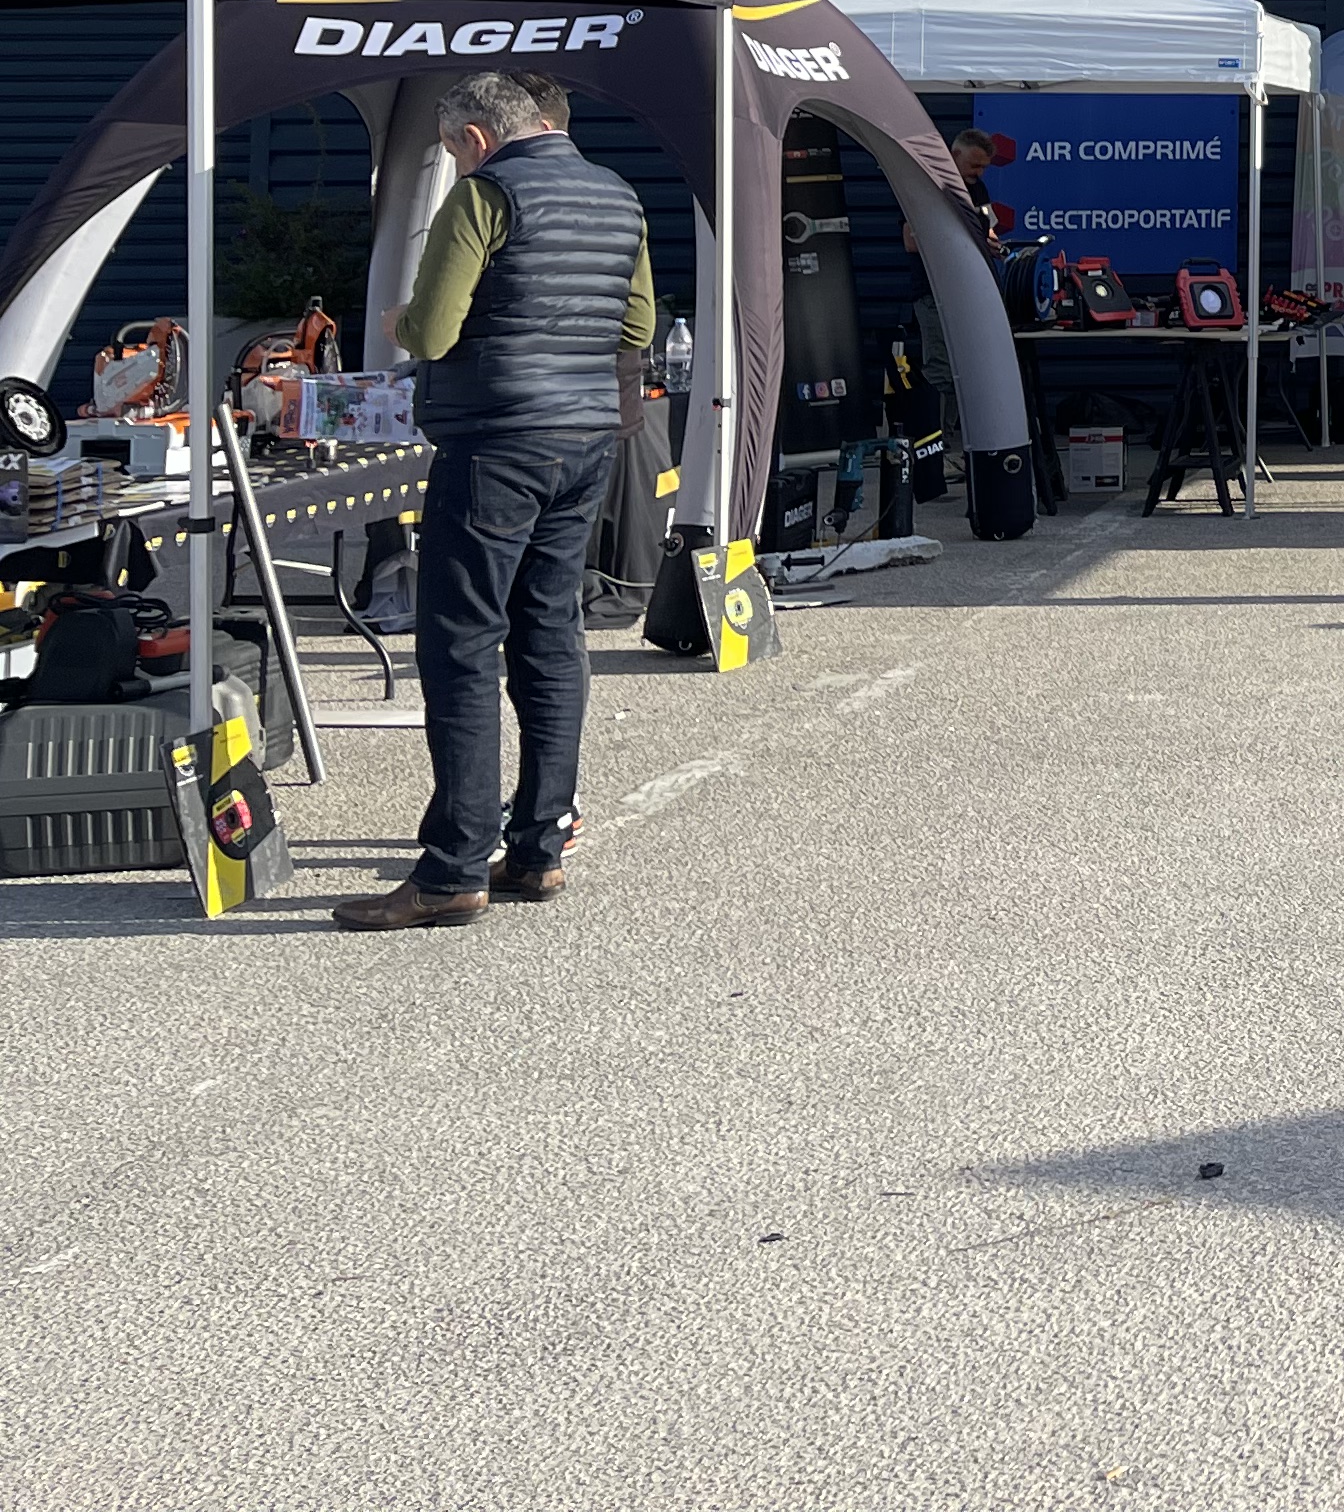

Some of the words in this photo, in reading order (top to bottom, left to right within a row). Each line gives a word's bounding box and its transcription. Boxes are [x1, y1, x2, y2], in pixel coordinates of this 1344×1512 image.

[1025, 141, 1071, 161] AIR
[1078, 135, 1221, 161] COMPRIMÉ
[1023, 205, 1231, 230] ÉLECTROPORTATIF
